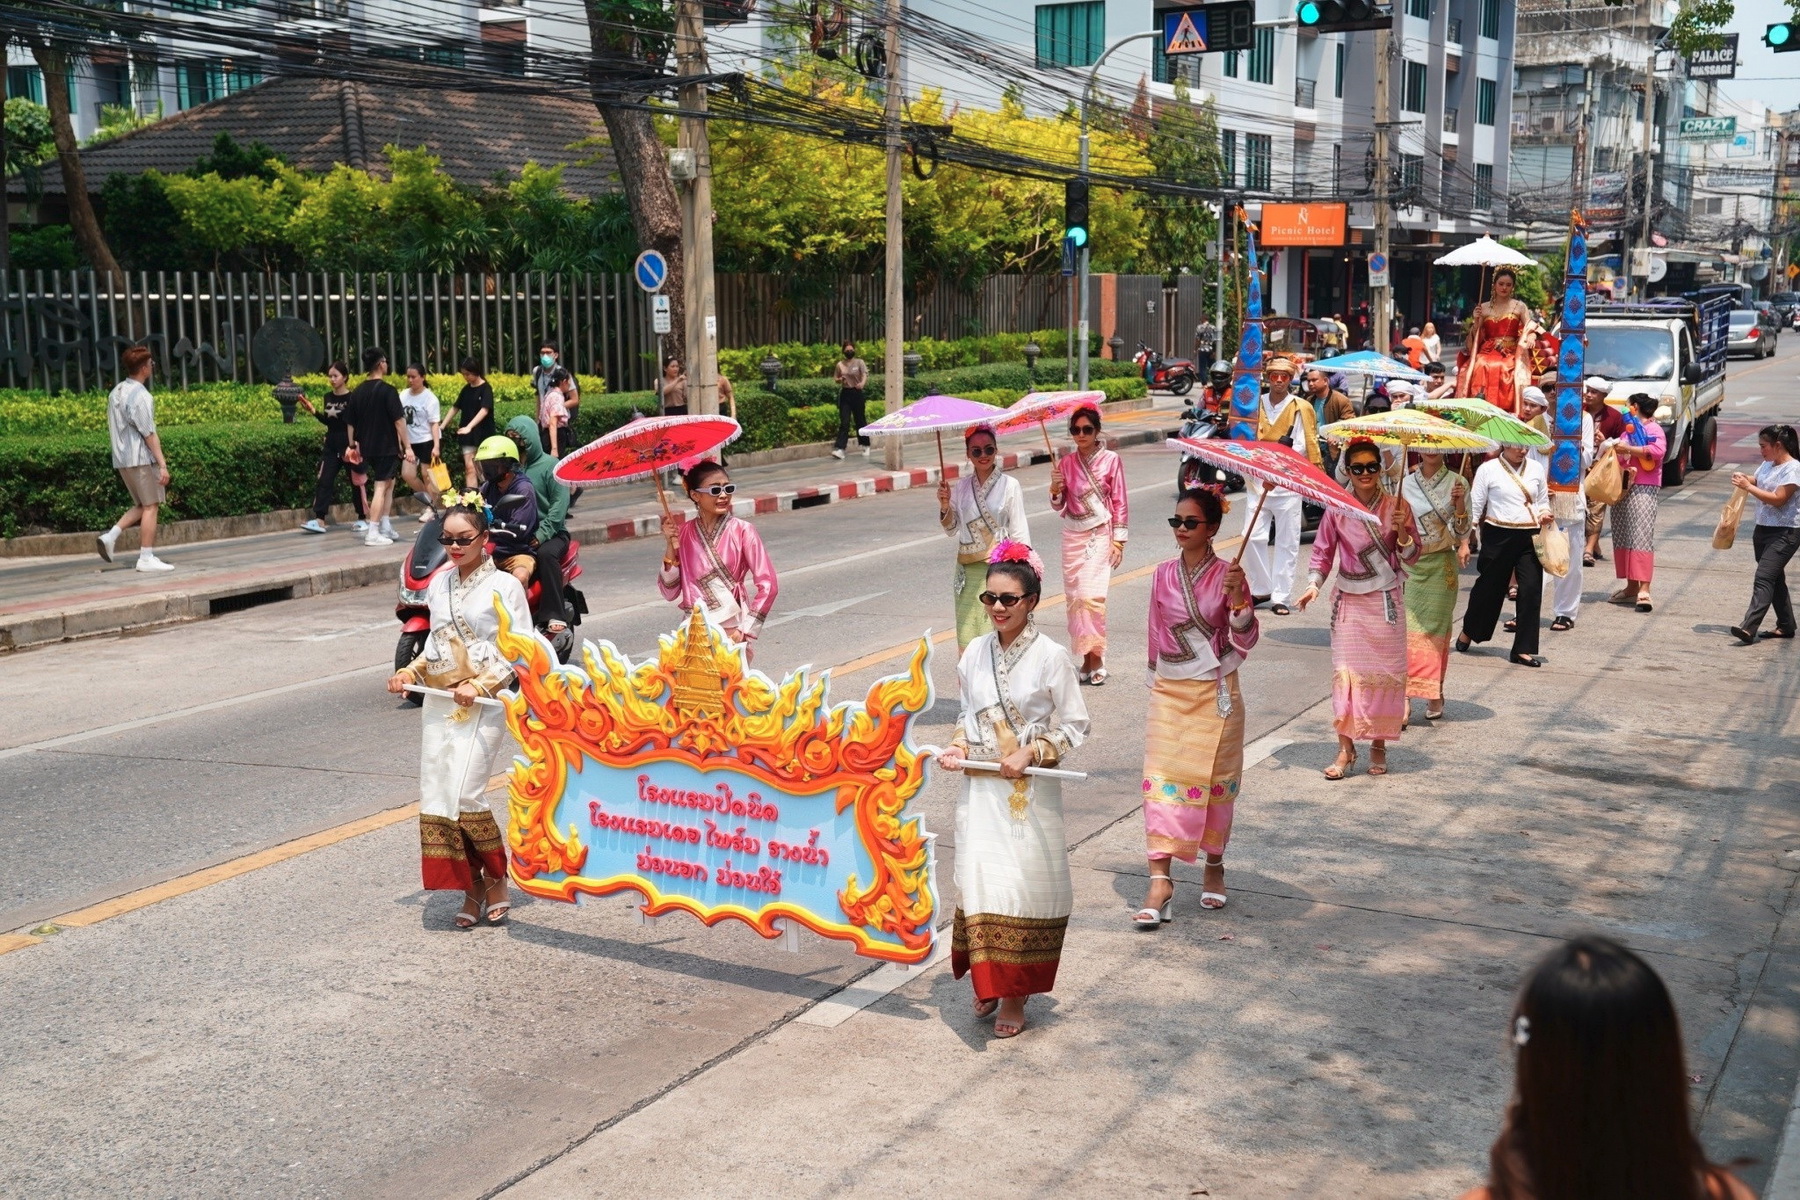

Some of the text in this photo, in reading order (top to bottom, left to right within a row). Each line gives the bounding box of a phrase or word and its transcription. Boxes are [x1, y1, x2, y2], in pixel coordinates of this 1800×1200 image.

[1692, 49, 1734, 63] PALACE
[1690, 65, 1732, 76] MASSAGE
[1684, 118, 1730, 132] CRAZY
[1271, 226, 1335, 235] Picnic Hotel
[589, 801, 701, 843] โรงแรมเดอ
[768, 829, 829, 866] รางน้ำ
